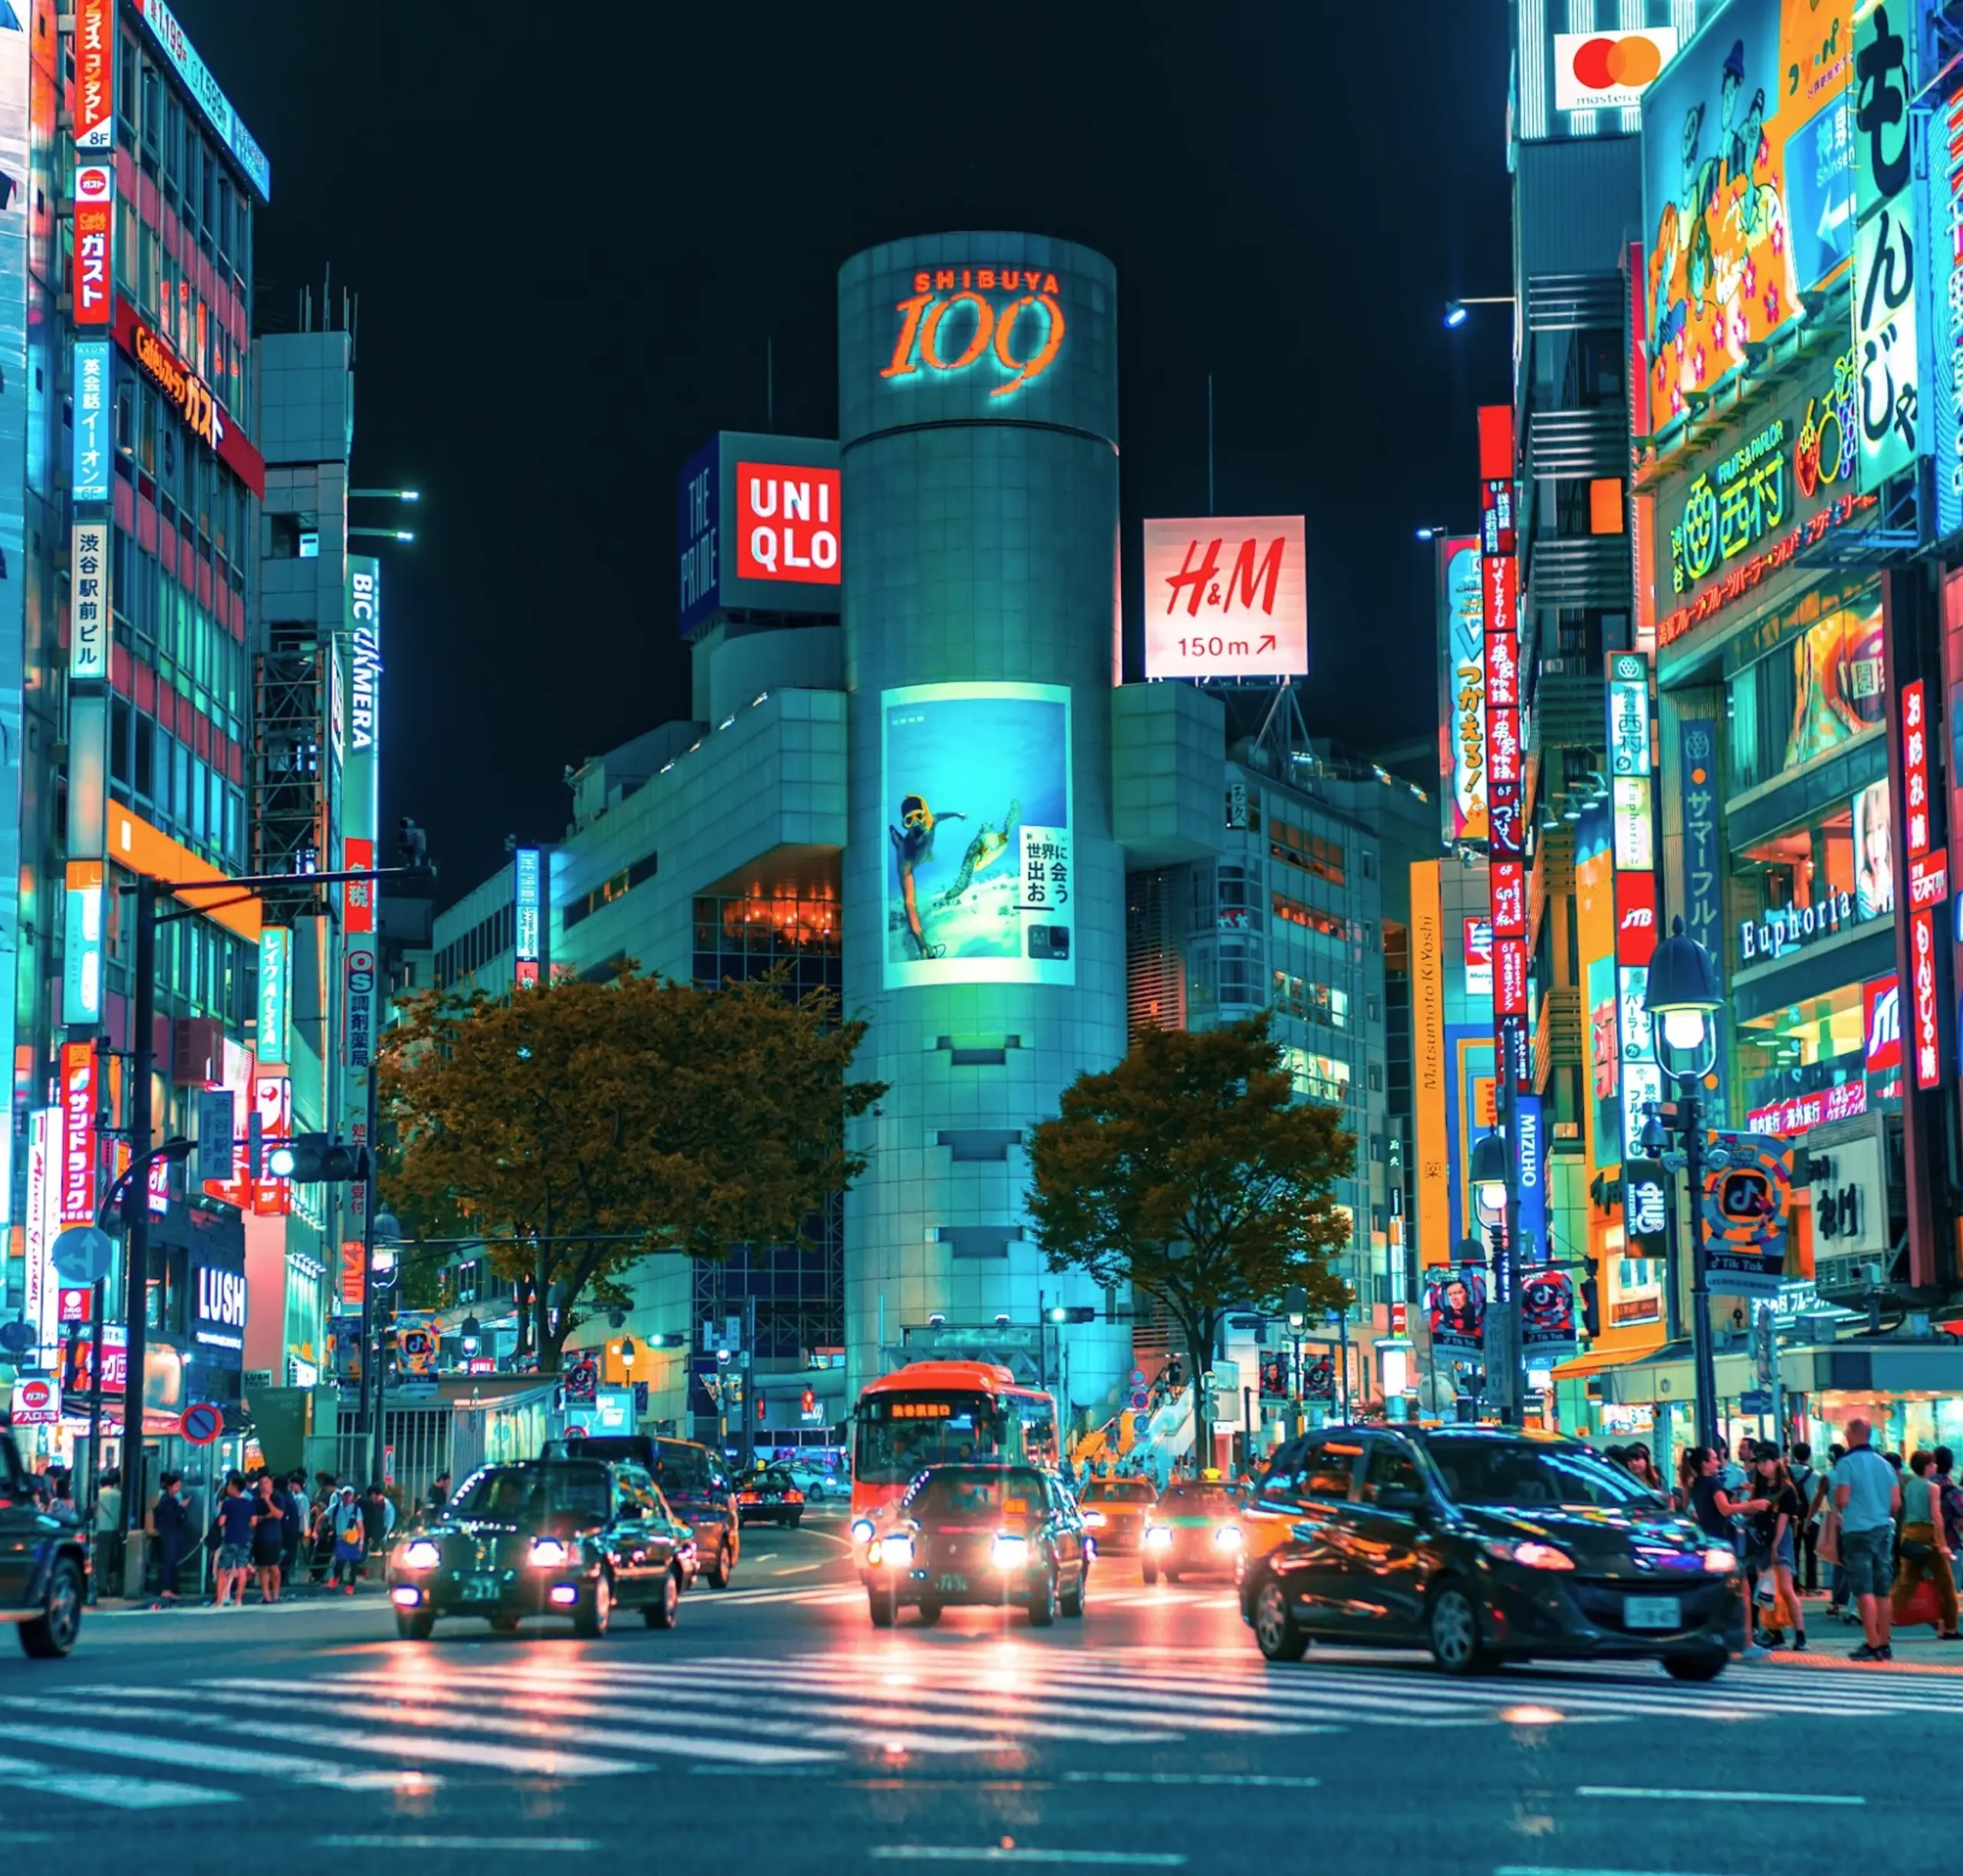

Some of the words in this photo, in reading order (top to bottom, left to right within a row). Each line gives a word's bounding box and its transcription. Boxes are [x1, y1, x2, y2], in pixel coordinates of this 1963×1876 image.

[84, 54, 102, 124] コンタクト
[1577, 93, 1642, 105] masterc
[90, 132, 109, 145] 8F
[82, 179, 105, 189] ガスト
[1856, 4, 1917, 452] もんじゃ
[81, 233, 105, 307] ガスト
[914, 269, 1060, 294] SHIBUYA
[880, 291, 1066, 396] 109
[185, 375, 223, 451] ガスト
[81, 488, 99, 500] 6F
[689, 467, 710, 540] THE
[751, 478, 829, 523] UNI
[1720, 450, 1785, 560] 西村
[681, 527, 717, 613] PRIME
[751, 526, 837, 573] QLO
[78, 534, 99, 665] 渋谷駅前ビル
[353, 573, 373, 620] BIC
[1166, 537, 1286, 618] H&M
[352, 627, 383, 750] CAMERA
[1497, 787, 1512, 797] 6F
[1026, 842, 1067, 860] 世界に
[1028, 860, 1067, 882] 出会
[1499, 865, 1513, 876] 6F
[1028, 882, 1067, 904] おう
[1687, 790, 1718, 964] サマーフルー
[1620, 908, 1653, 930] JTB
[1740, 889, 1853, 960] Euphoria
[1501, 942, 1515, 953] 6F
[350, 952, 374, 994] OS
[350, 995, 369, 1067] 調剤薬局
[1625, 994, 1638, 1040] パーラー
[1629, 1089, 1642, 1138] フルーツ
[1786, 1101, 1822, 1129] 海外旅行
[1828, 1083, 1863, 1107] ハネムーン
[67, 1093, 90, 1210] サンドラッグ
[1521, 1114, 1537, 1187] MIZUHO
[199, 1266, 245, 1328] LUSH
